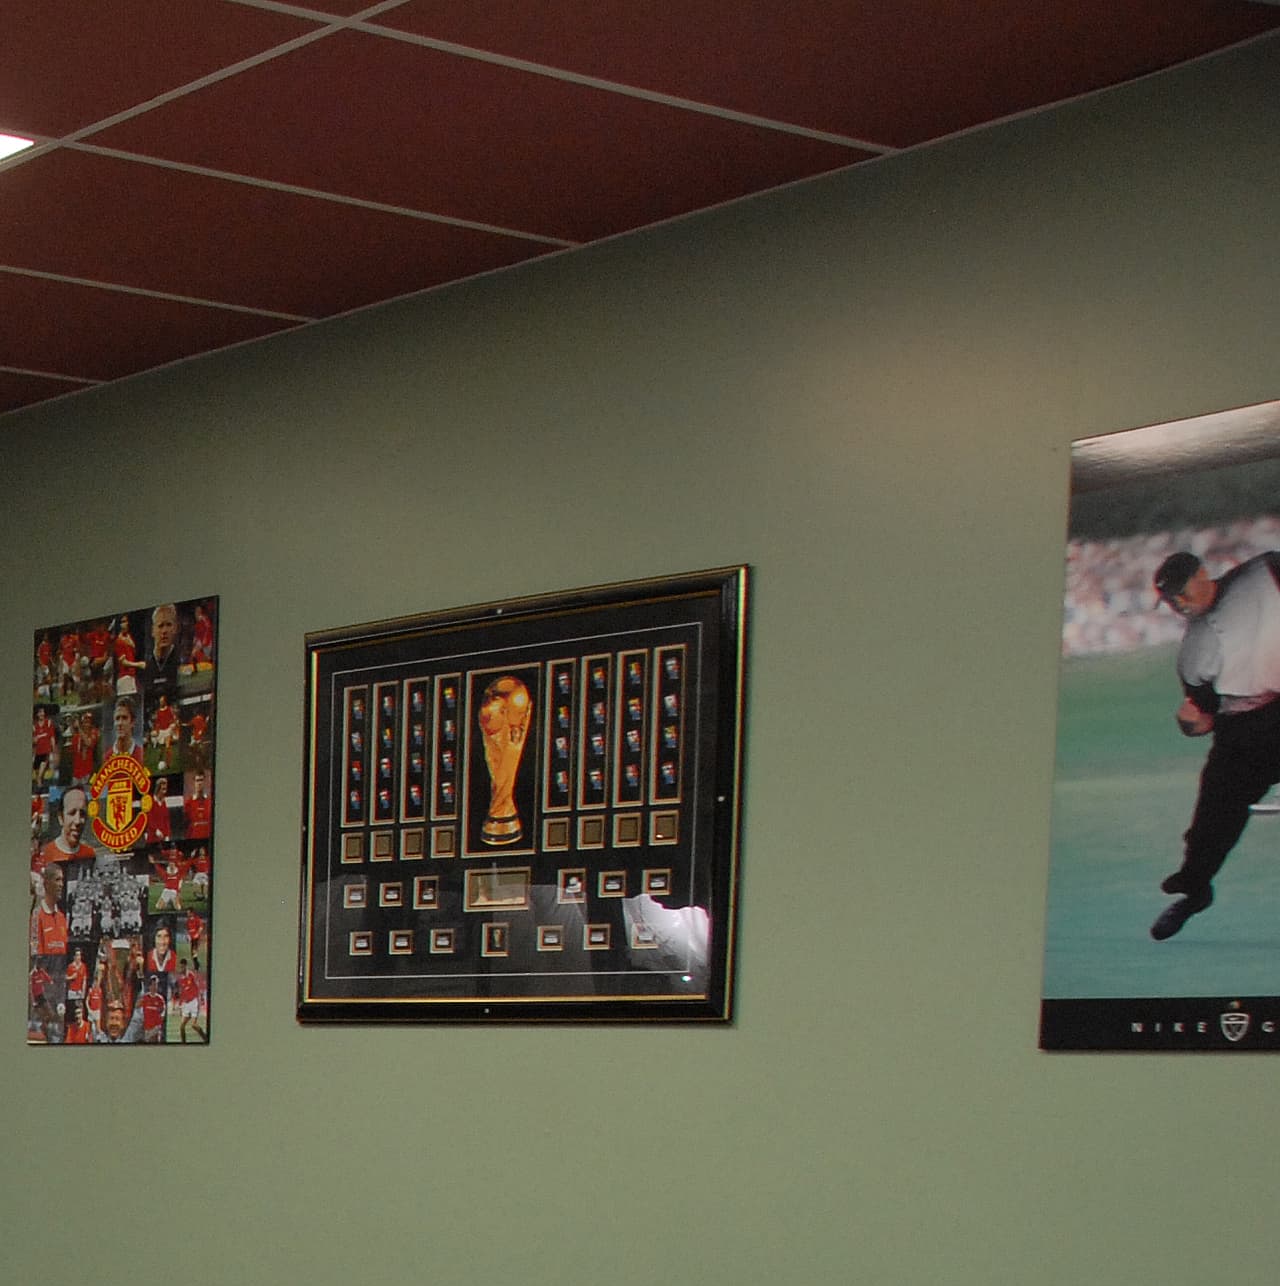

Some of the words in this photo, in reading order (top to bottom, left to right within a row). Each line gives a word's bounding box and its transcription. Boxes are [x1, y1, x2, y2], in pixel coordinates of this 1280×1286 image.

[93, 759, 146, 793] MANCHESTER
[100, 827, 138, 846] UNITED
[1130, 1021, 1207, 1033] NIKE
